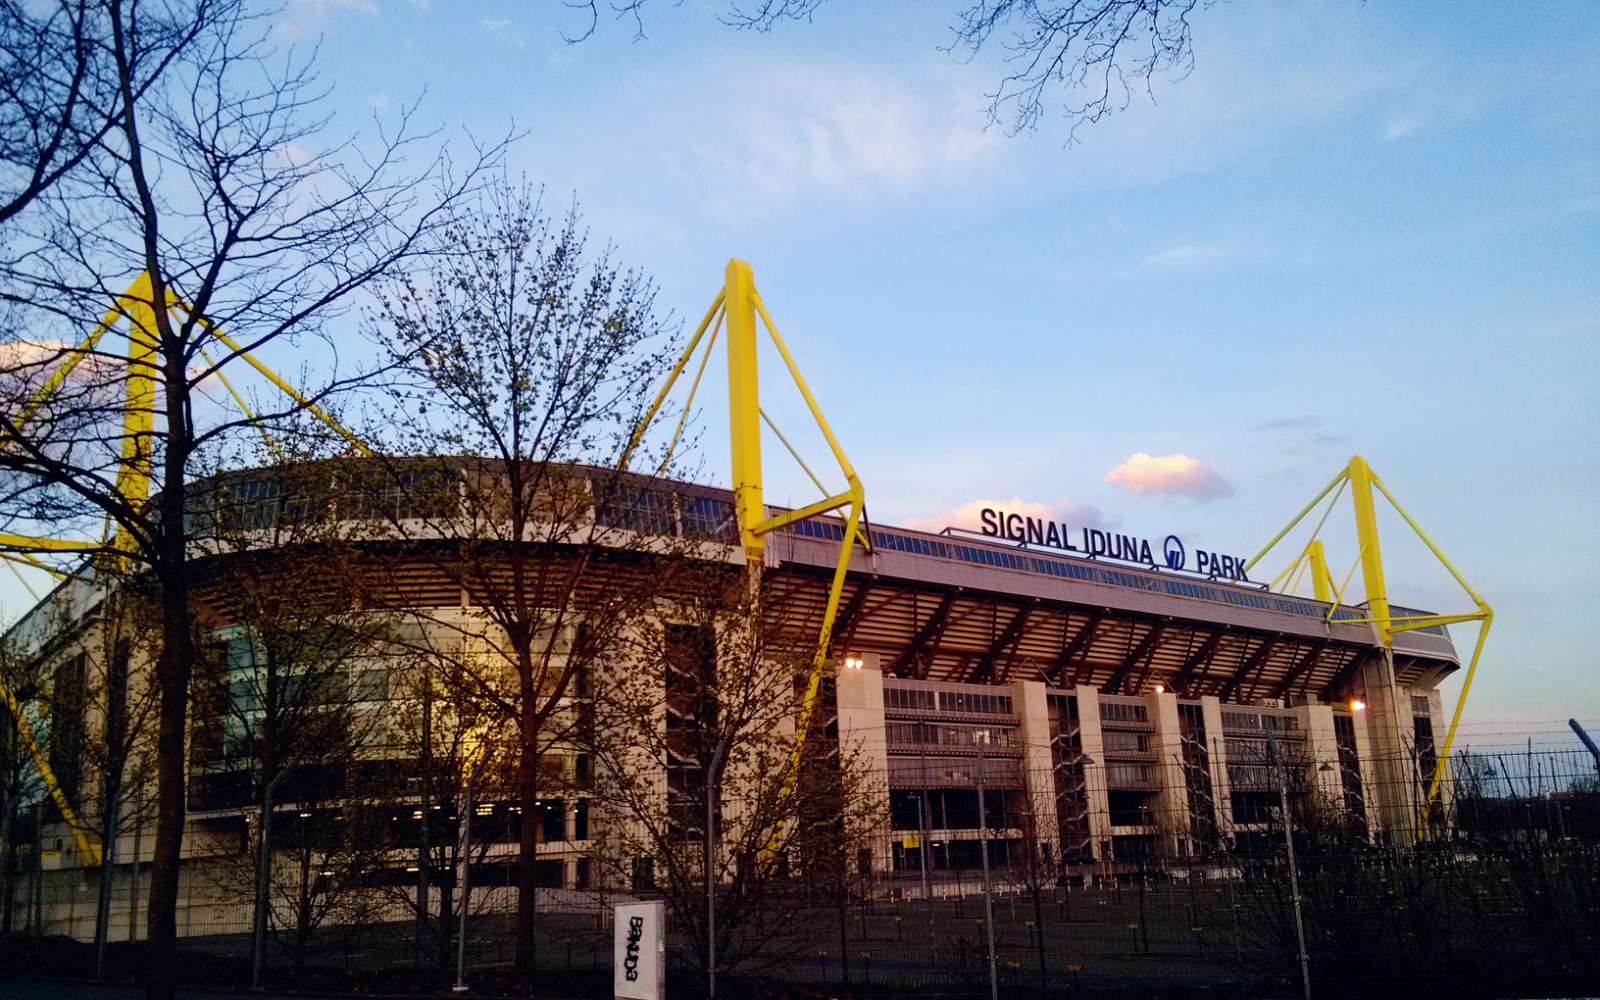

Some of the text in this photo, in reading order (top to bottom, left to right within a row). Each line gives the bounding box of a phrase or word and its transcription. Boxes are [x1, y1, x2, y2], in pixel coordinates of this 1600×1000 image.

[981, 508, 1249, 582] SIGNAL IDUNA PARK
